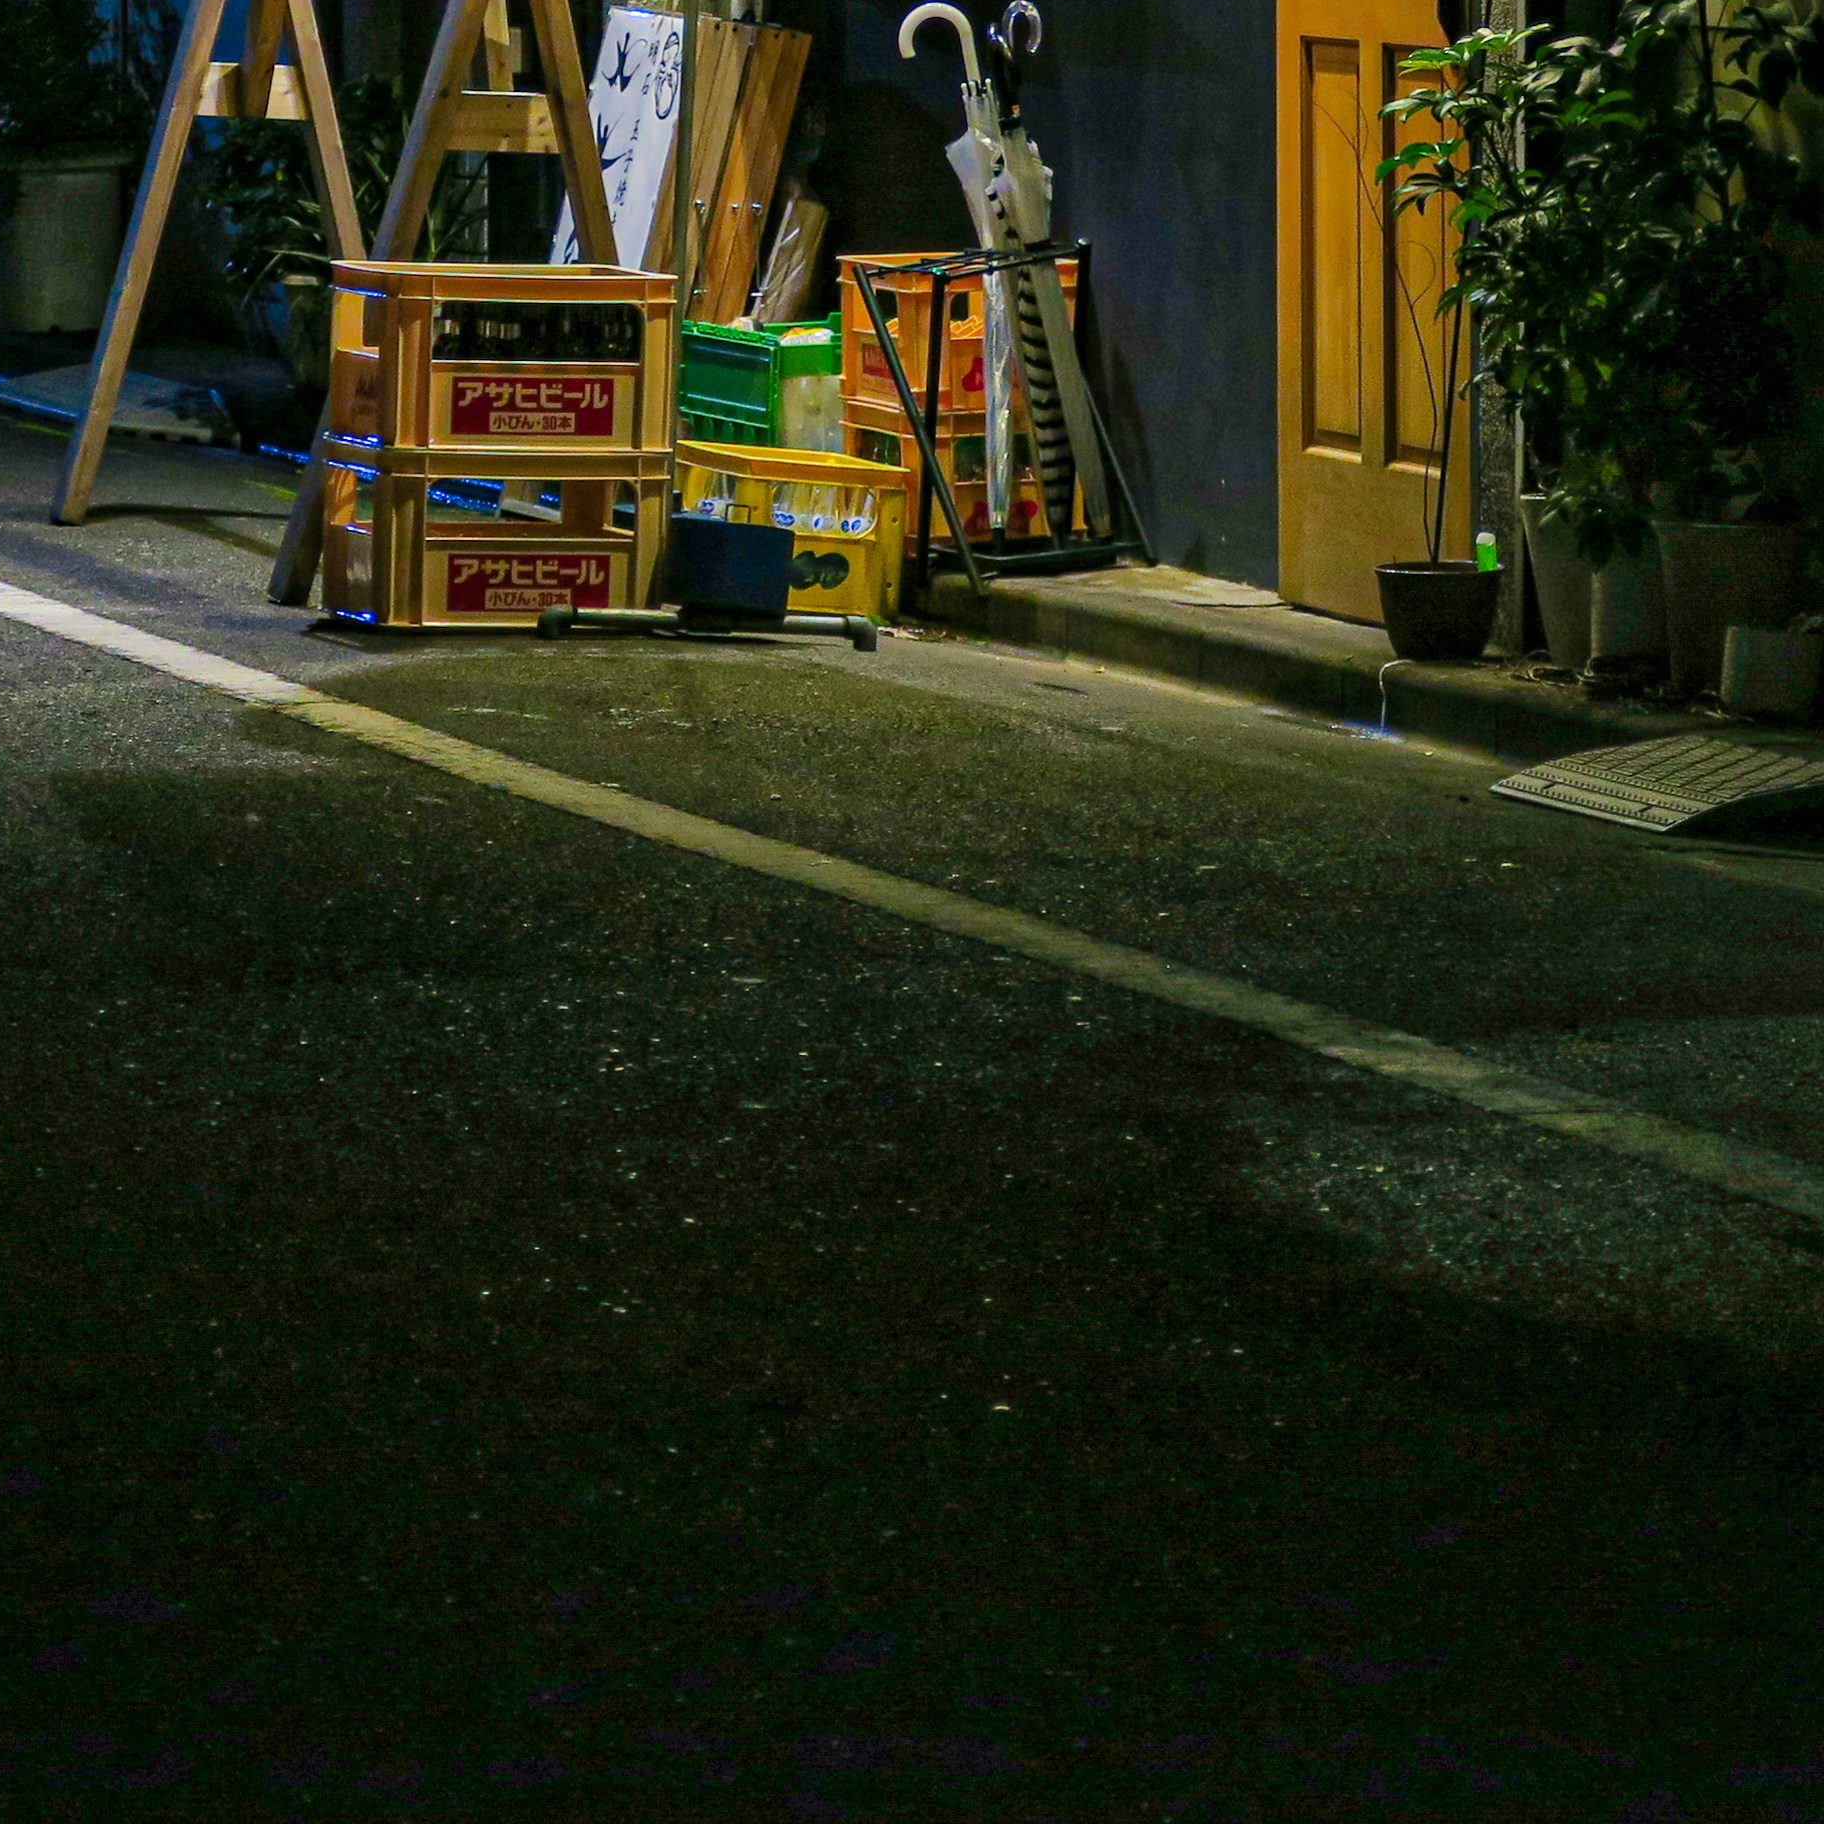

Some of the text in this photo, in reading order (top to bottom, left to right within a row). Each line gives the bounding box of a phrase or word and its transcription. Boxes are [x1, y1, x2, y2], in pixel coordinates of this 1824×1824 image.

[457, 381, 609, 409] アサヒビール
[453, 558, 605, 586] アサヒビール
